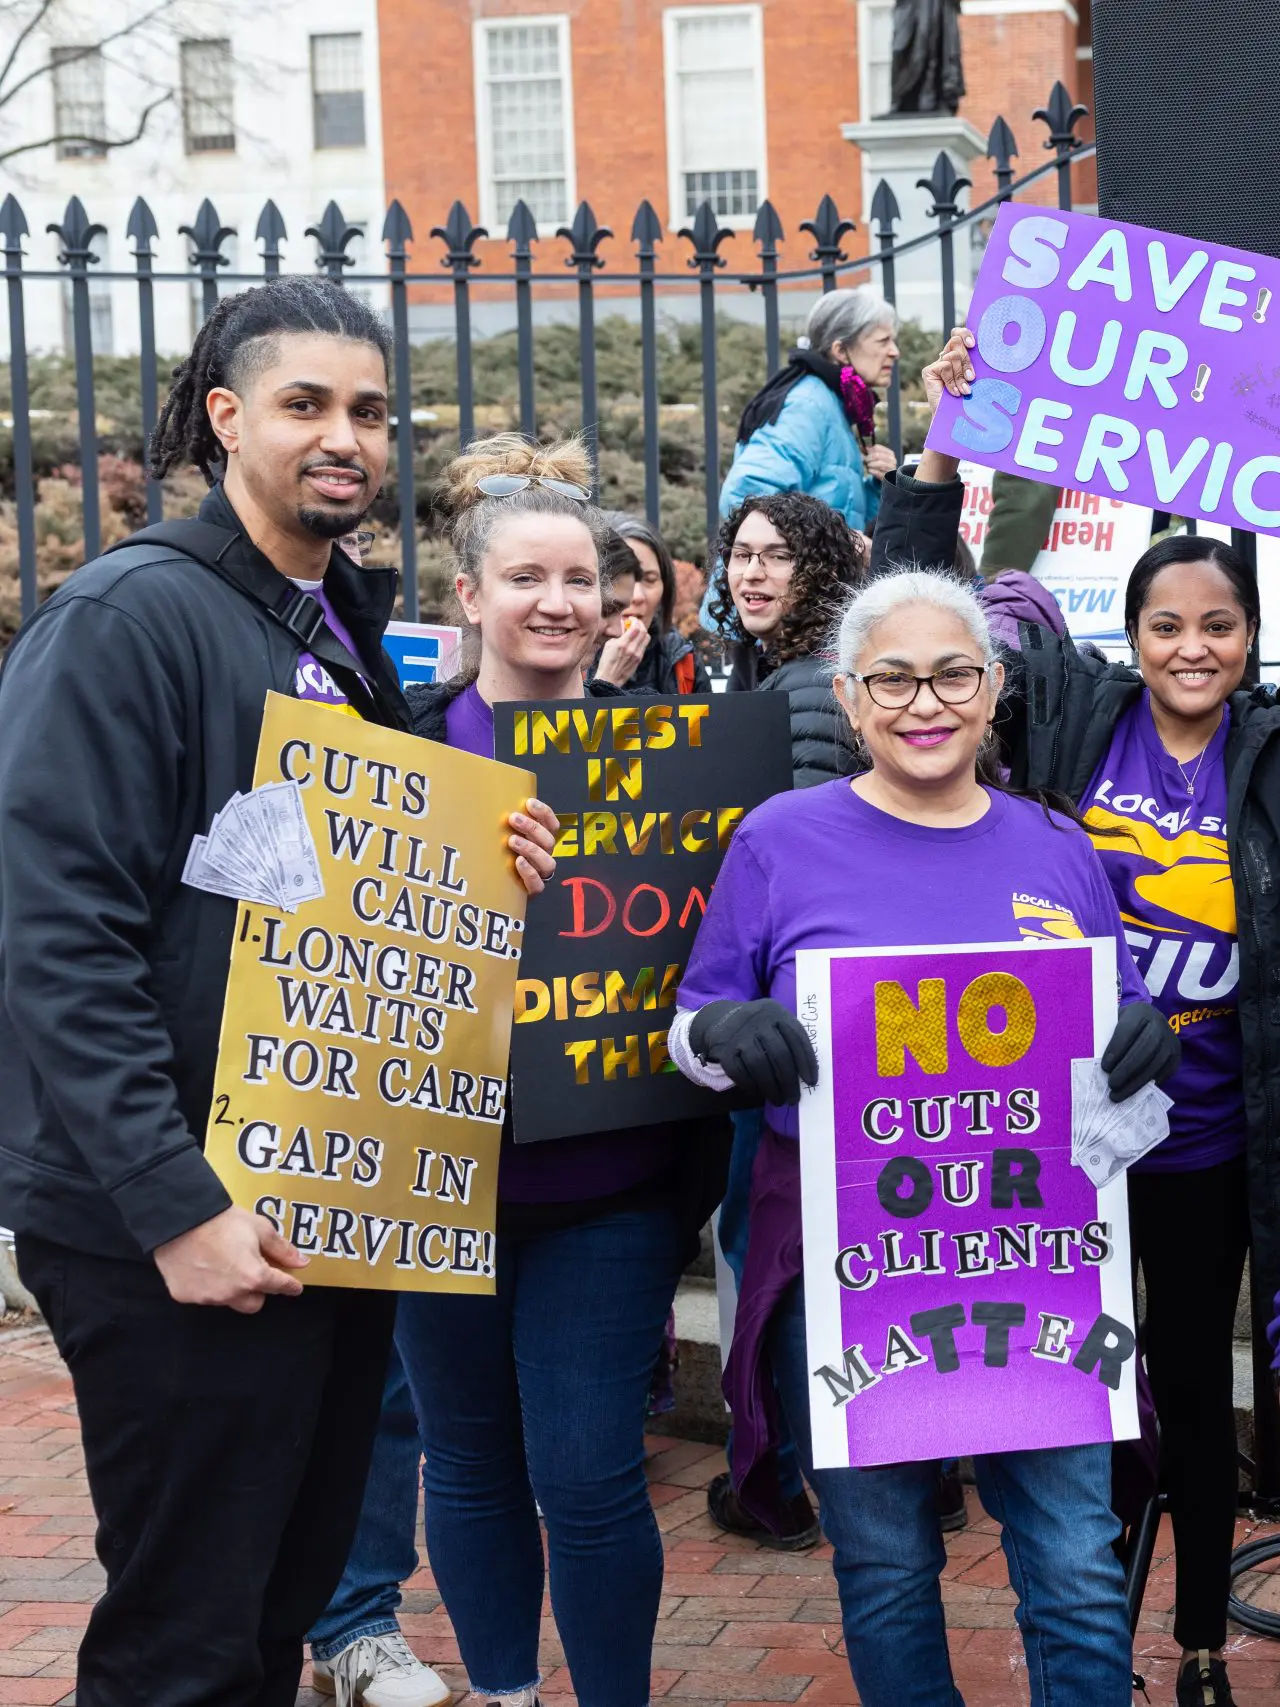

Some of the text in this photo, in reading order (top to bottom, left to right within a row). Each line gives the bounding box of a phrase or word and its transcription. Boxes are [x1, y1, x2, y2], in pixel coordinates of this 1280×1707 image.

[1002, 216, 1272, 333] SAVE!
[977, 295, 1211, 409] OUR!
[514, 704, 710, 756] INVEST
[278, 738, 431, 817] CUTS
[587, 758, 643, 802] IN
[322, 808, 467, 898] WILL
[552, 807, 744, 858] ERVICE
[352, 876, 526, 960] CAUSE:
[276, 974, 448, 1055] WAITS
[874, 971, 1037, 1078] NO
[242, 1034, 506, 1125] FOR CARE
[861, 1088, 1040, 1144] CUTS
[237, 1118, 479, 1206] GAPS IN
[876, 1147, 1045, 1219] OUR
[253, 1194, 496, 1280] SERVICE!
[833, 1220, 1114, 1291] CLIENTS
[812, 1300, 1137, 1408] MATTER
